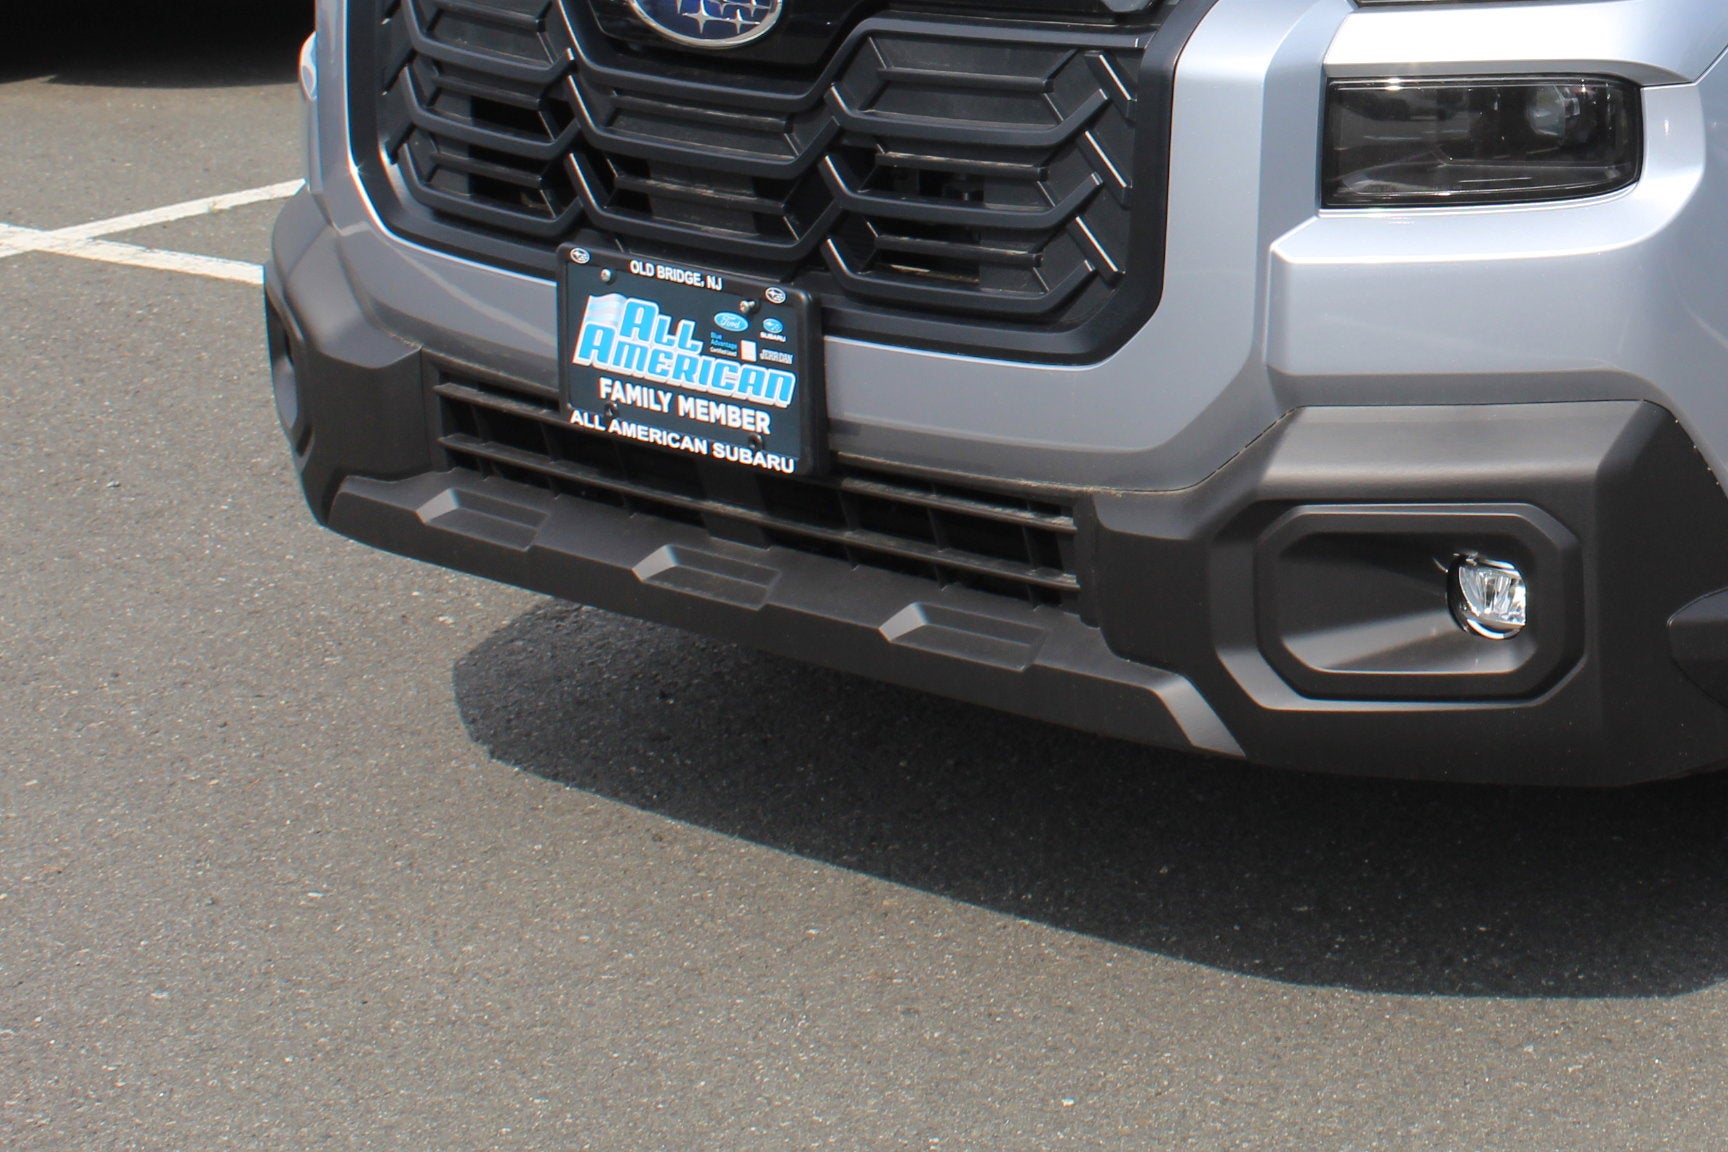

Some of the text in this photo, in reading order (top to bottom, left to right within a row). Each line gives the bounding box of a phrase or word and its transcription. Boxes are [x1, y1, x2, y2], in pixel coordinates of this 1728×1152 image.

[629, 259, 723, 291] OLD BRIDGE, NJ
[598, 377, 770, 435] FAMILY MEMBER
[569, 409, 795, 474] ALL AMERICAN SUBARU
